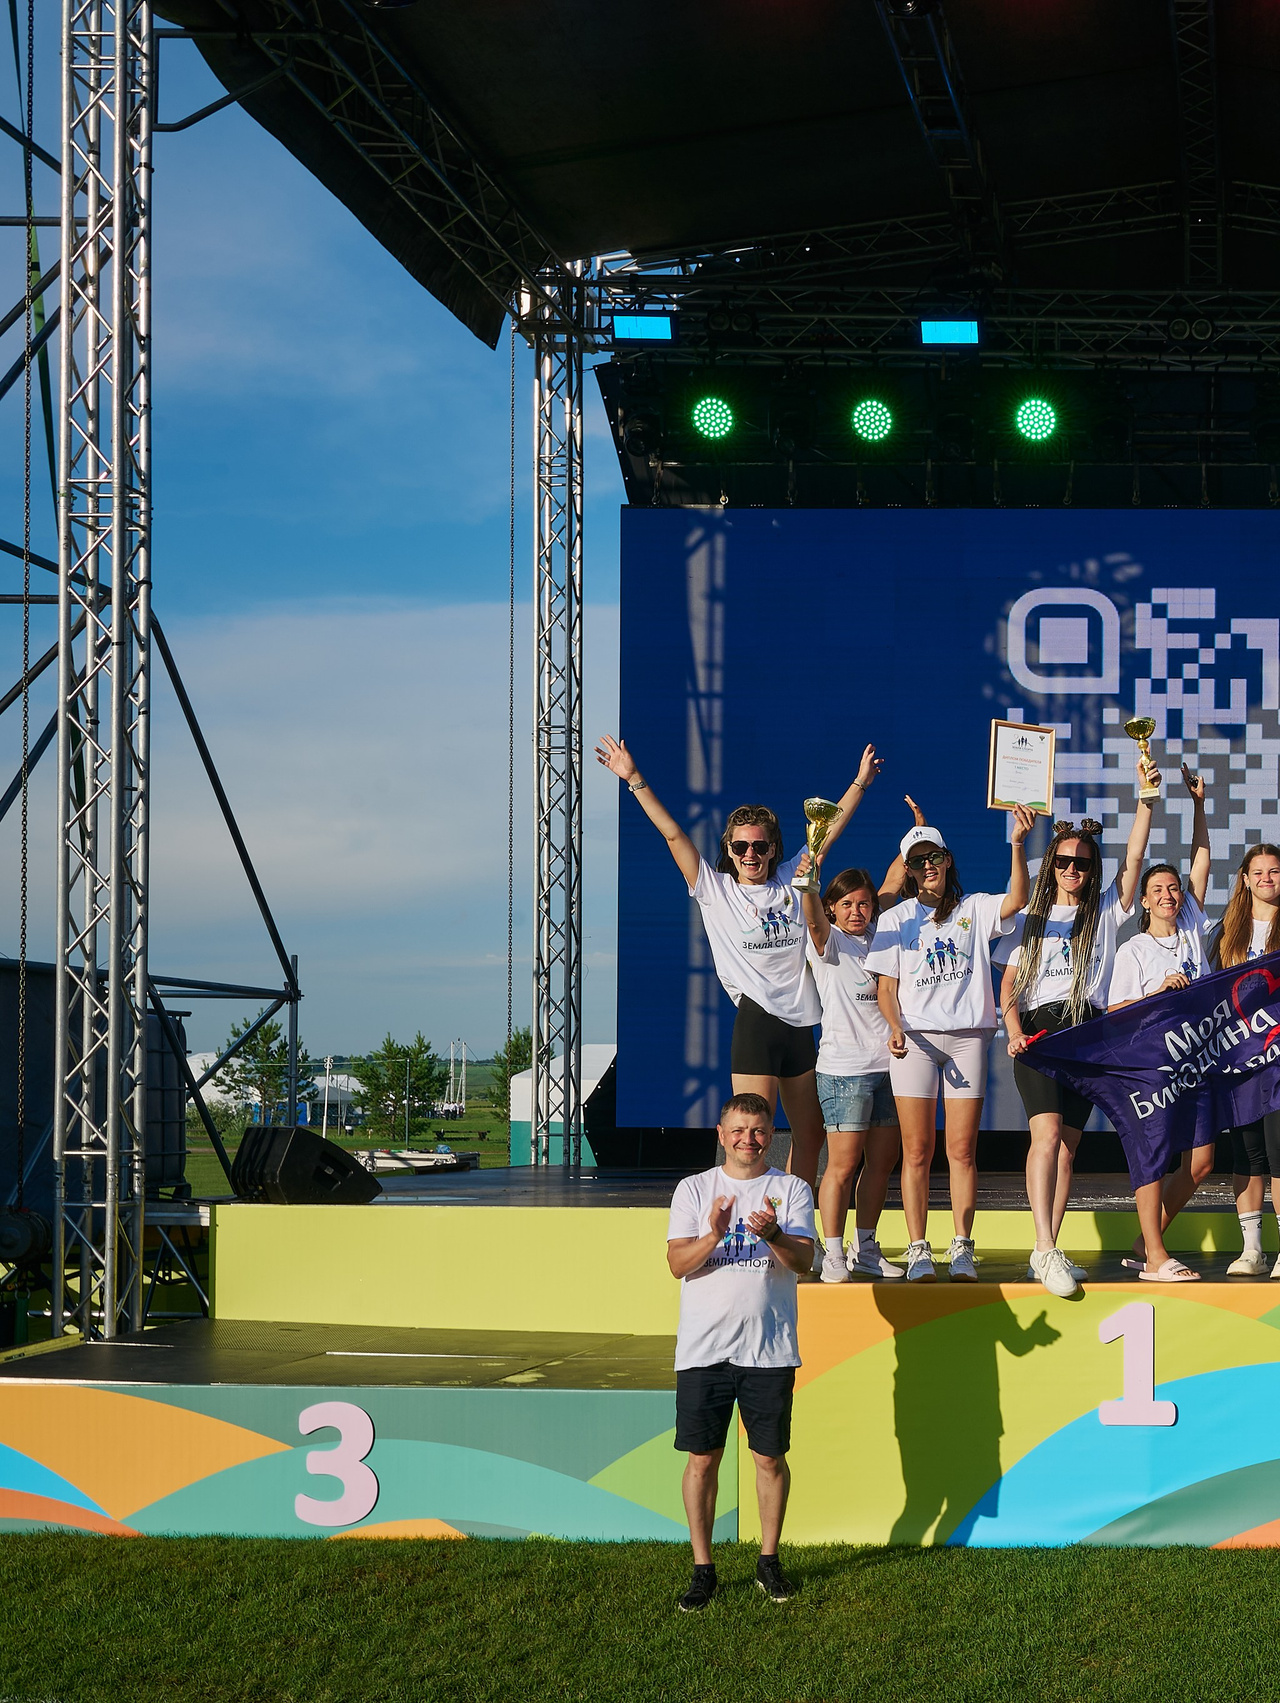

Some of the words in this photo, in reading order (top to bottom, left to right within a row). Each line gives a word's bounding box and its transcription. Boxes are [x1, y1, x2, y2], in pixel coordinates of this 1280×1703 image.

[742, 941, 773, 950] ЗЕМЛЯ
[775, 936, 802, 948] СПОРТ
[855, 993, 878, 1001] ЗЕМЛ
[1165, 1000, 1232, 1062] Моя
[704, 1257, 734, 1267] ЗЕМЛЯ
[737, 1257, 776, 1269] СПОРТА
[1098, 1302, 1178, 1426] 1
[295, 1401, 379, 1527] 3
